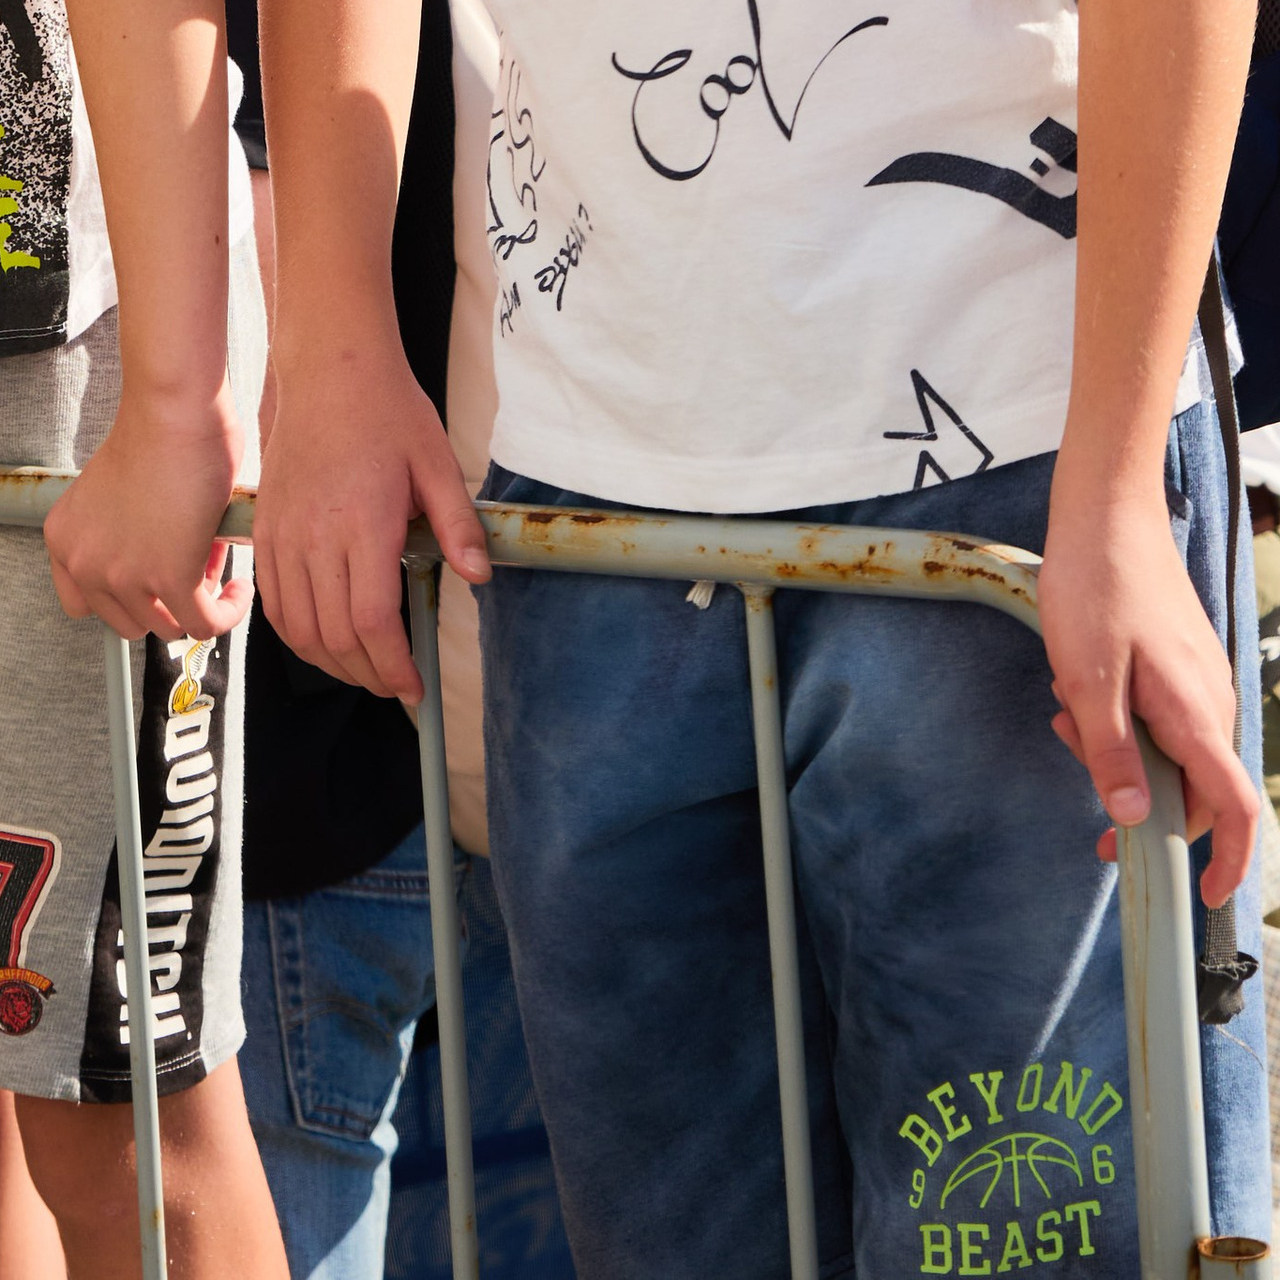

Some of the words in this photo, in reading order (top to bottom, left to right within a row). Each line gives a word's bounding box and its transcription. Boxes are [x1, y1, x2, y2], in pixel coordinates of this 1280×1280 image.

[898, 1060, 1124, 1168] BEYOND
[1091, 1143, 1116, 1185] 6
[920, 1199, 1102, 1277] BEAST
